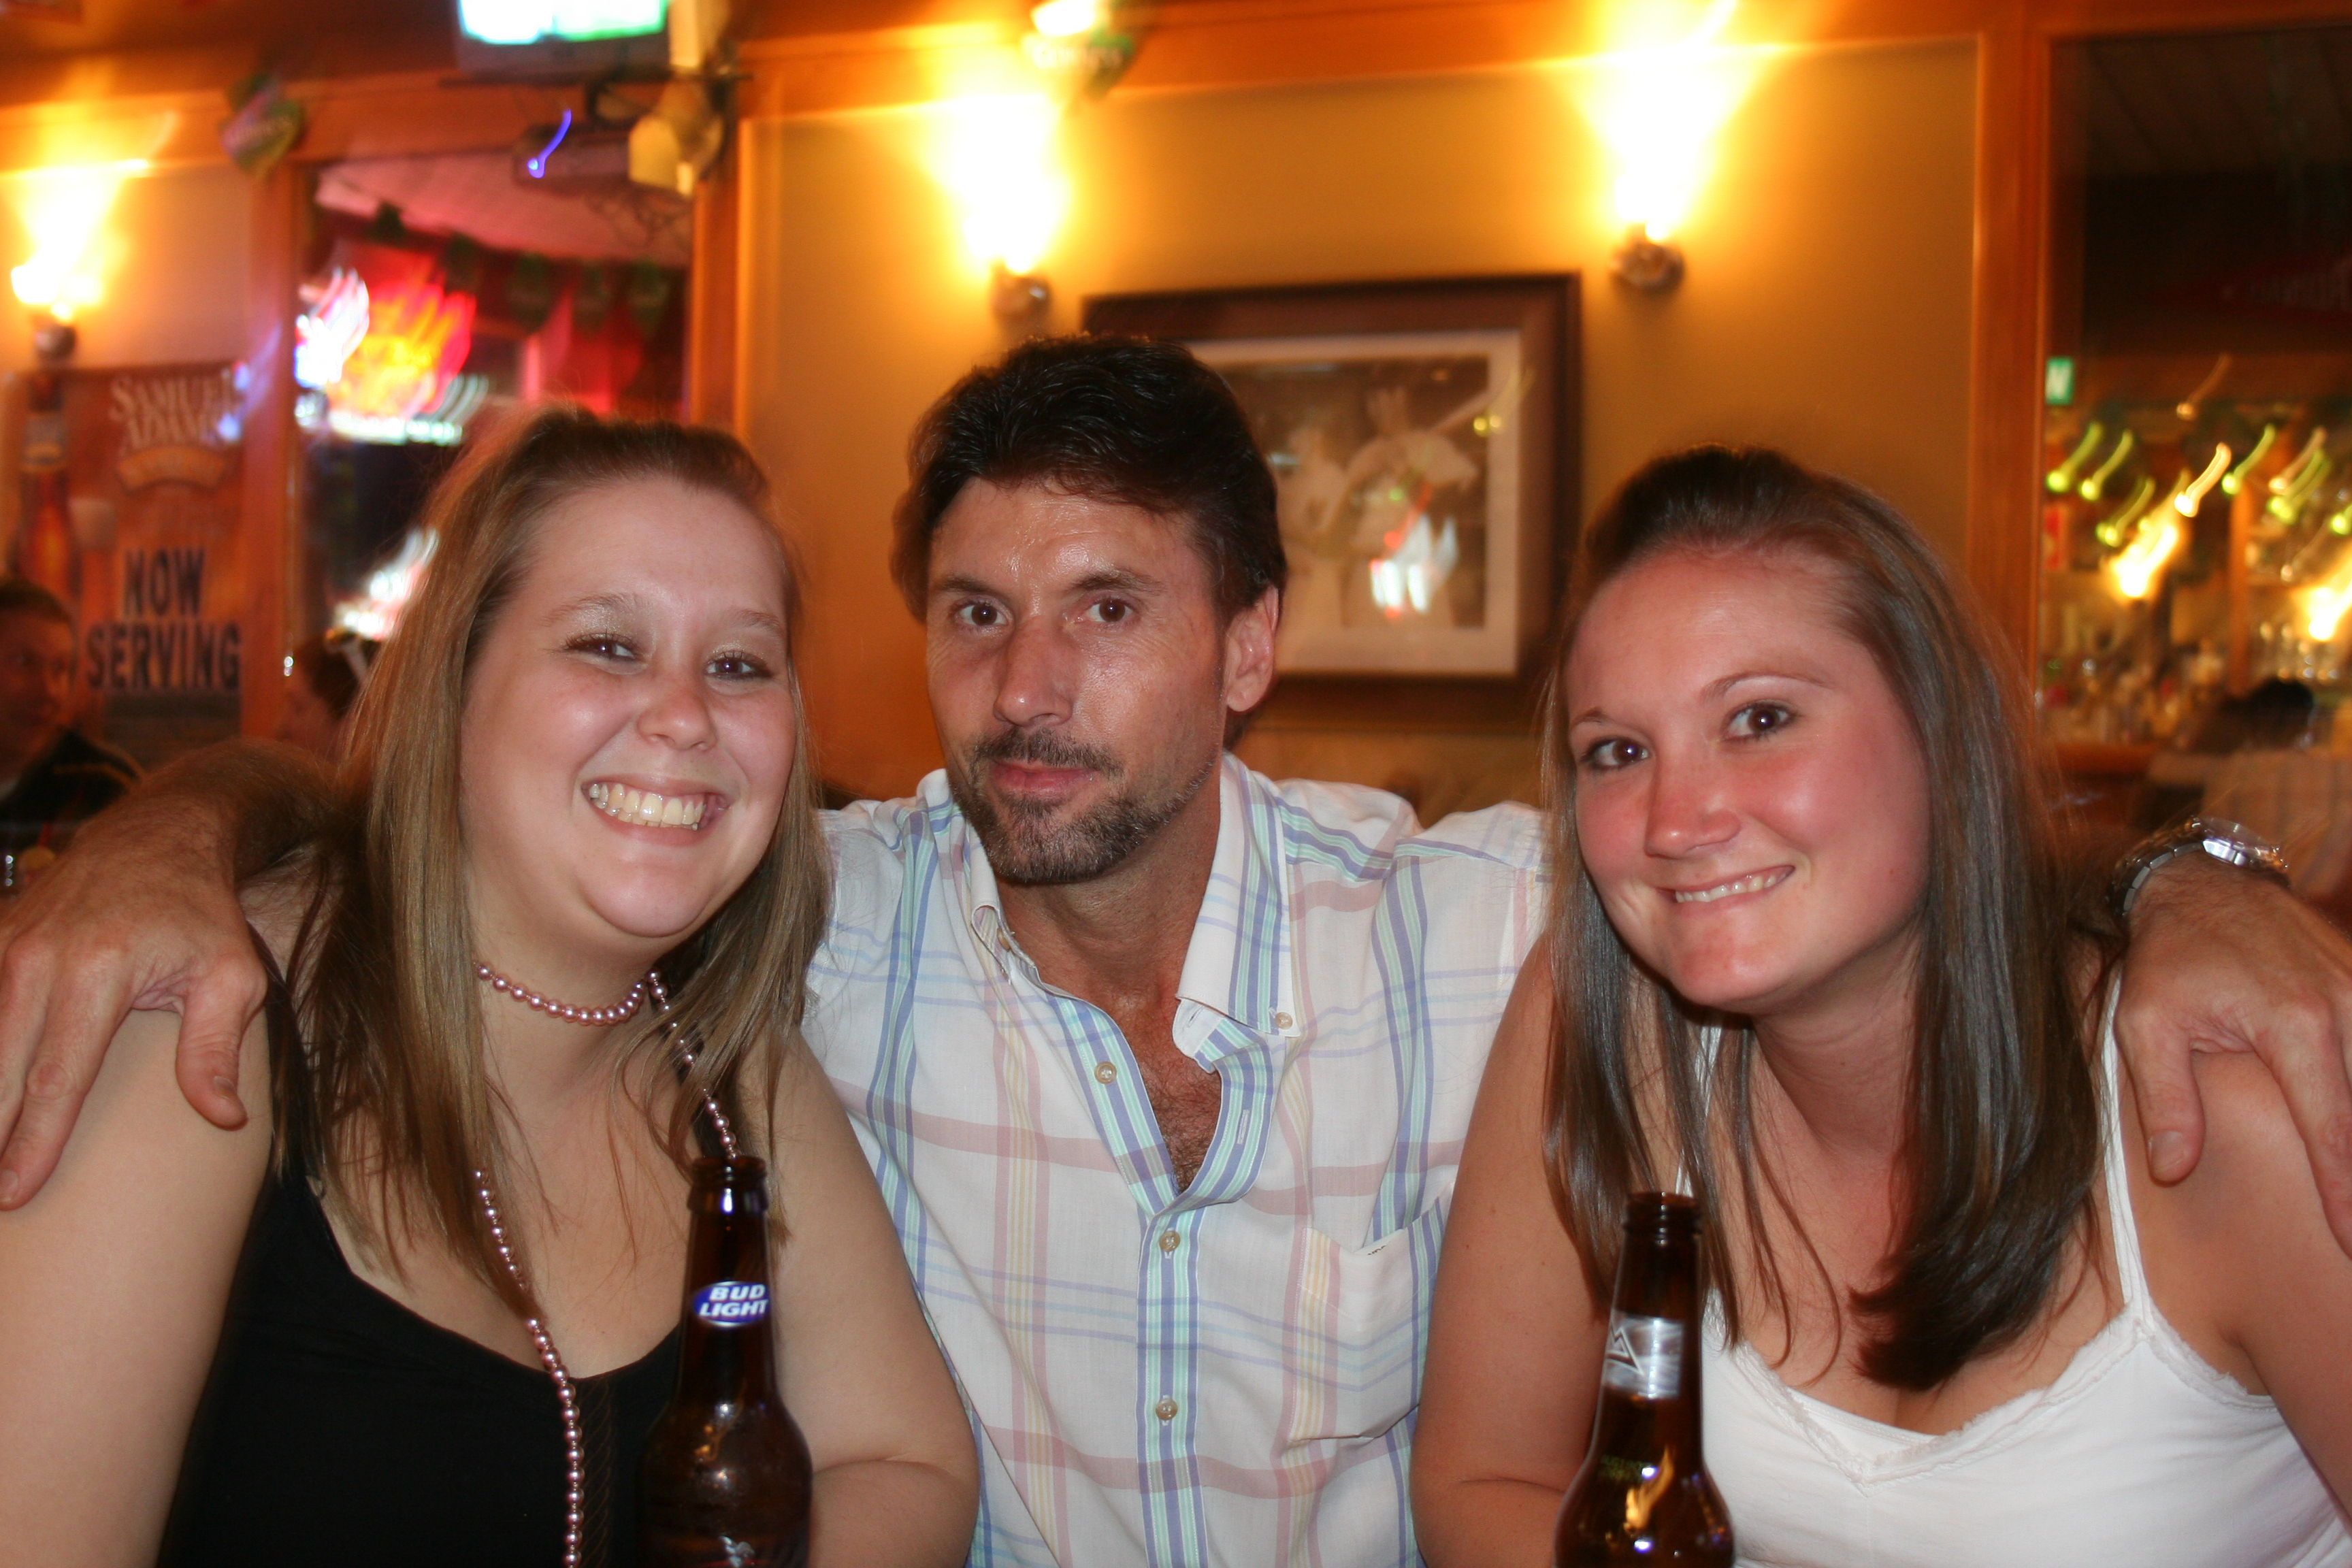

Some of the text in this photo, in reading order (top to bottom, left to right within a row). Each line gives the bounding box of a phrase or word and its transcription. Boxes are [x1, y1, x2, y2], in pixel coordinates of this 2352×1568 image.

[124, 546, 205, 617] NOW
[86, 621, 240, 690] SERVING
[699, 1298, 770, 1318] LIGHT
[708, 1284, 766, 1302] BUD
